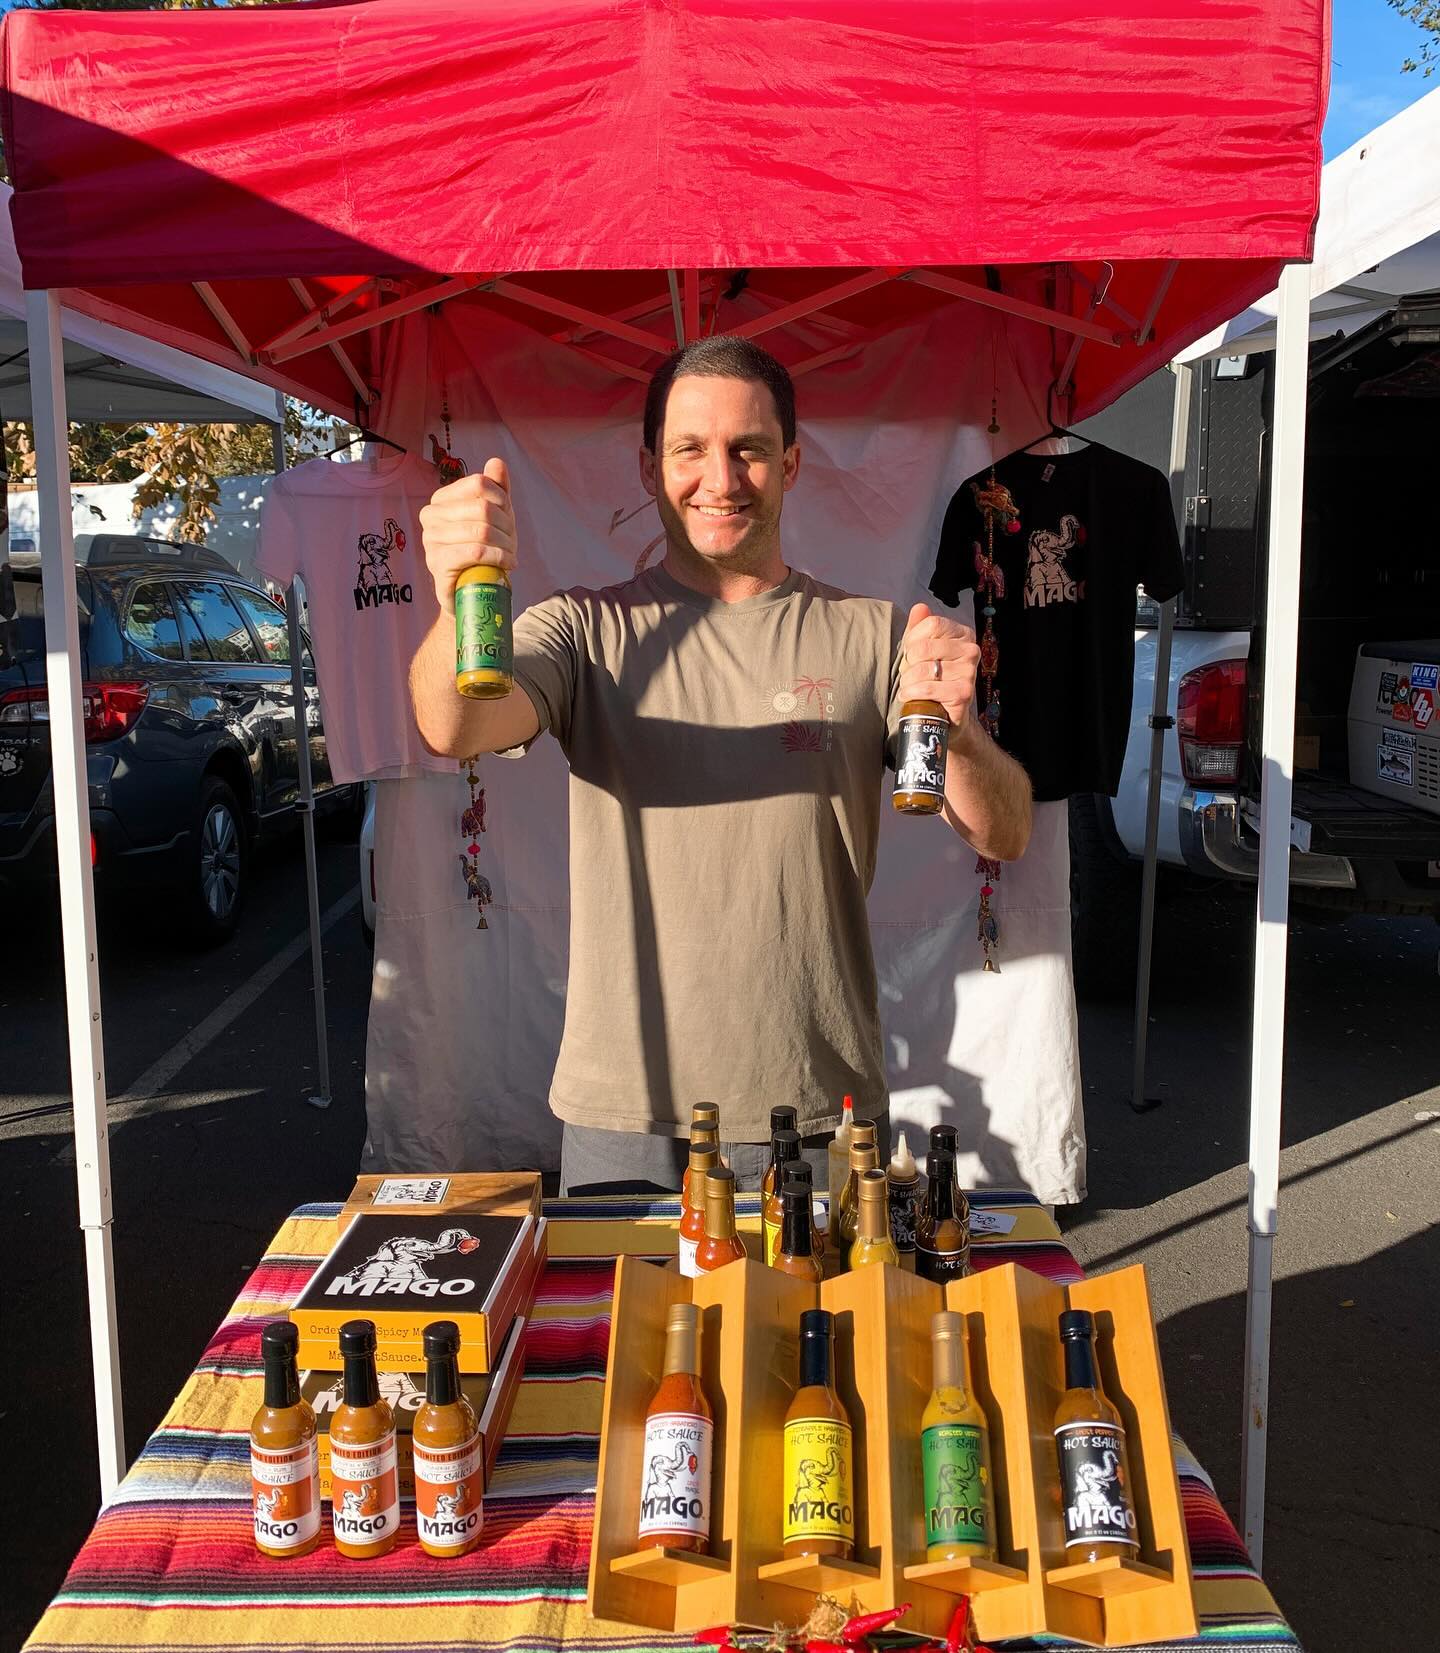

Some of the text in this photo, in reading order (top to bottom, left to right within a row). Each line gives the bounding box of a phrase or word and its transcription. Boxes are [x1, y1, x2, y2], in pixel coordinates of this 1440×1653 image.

[1412, 665, 1438, 679] KING
[903, 724, 922, 734] HOT
[898, 768, 945, 786] MAGO
[936, 1261, 956, 1270] HOT
[324, 1276, 476, 1297] MAGO
[377, 1326, 409, 1338] Spicy
[667, 1429, 704, 1442] SAUCE
[791, 1433, 849, 1449] HOT SAUCE
[1064, 1436, 1122, 1451] HOT SAUC
[929, 1438, 953, 1451] HOT
[641, 1497, 704, 1522] MAGO
[789, 1501, 852, 1525] MAGO
[335, 1512, 387, 1534] MAGO
[423, 1512, 479, 1538] MAGO
[1068, 1505, 1137, 1531] MAGO
